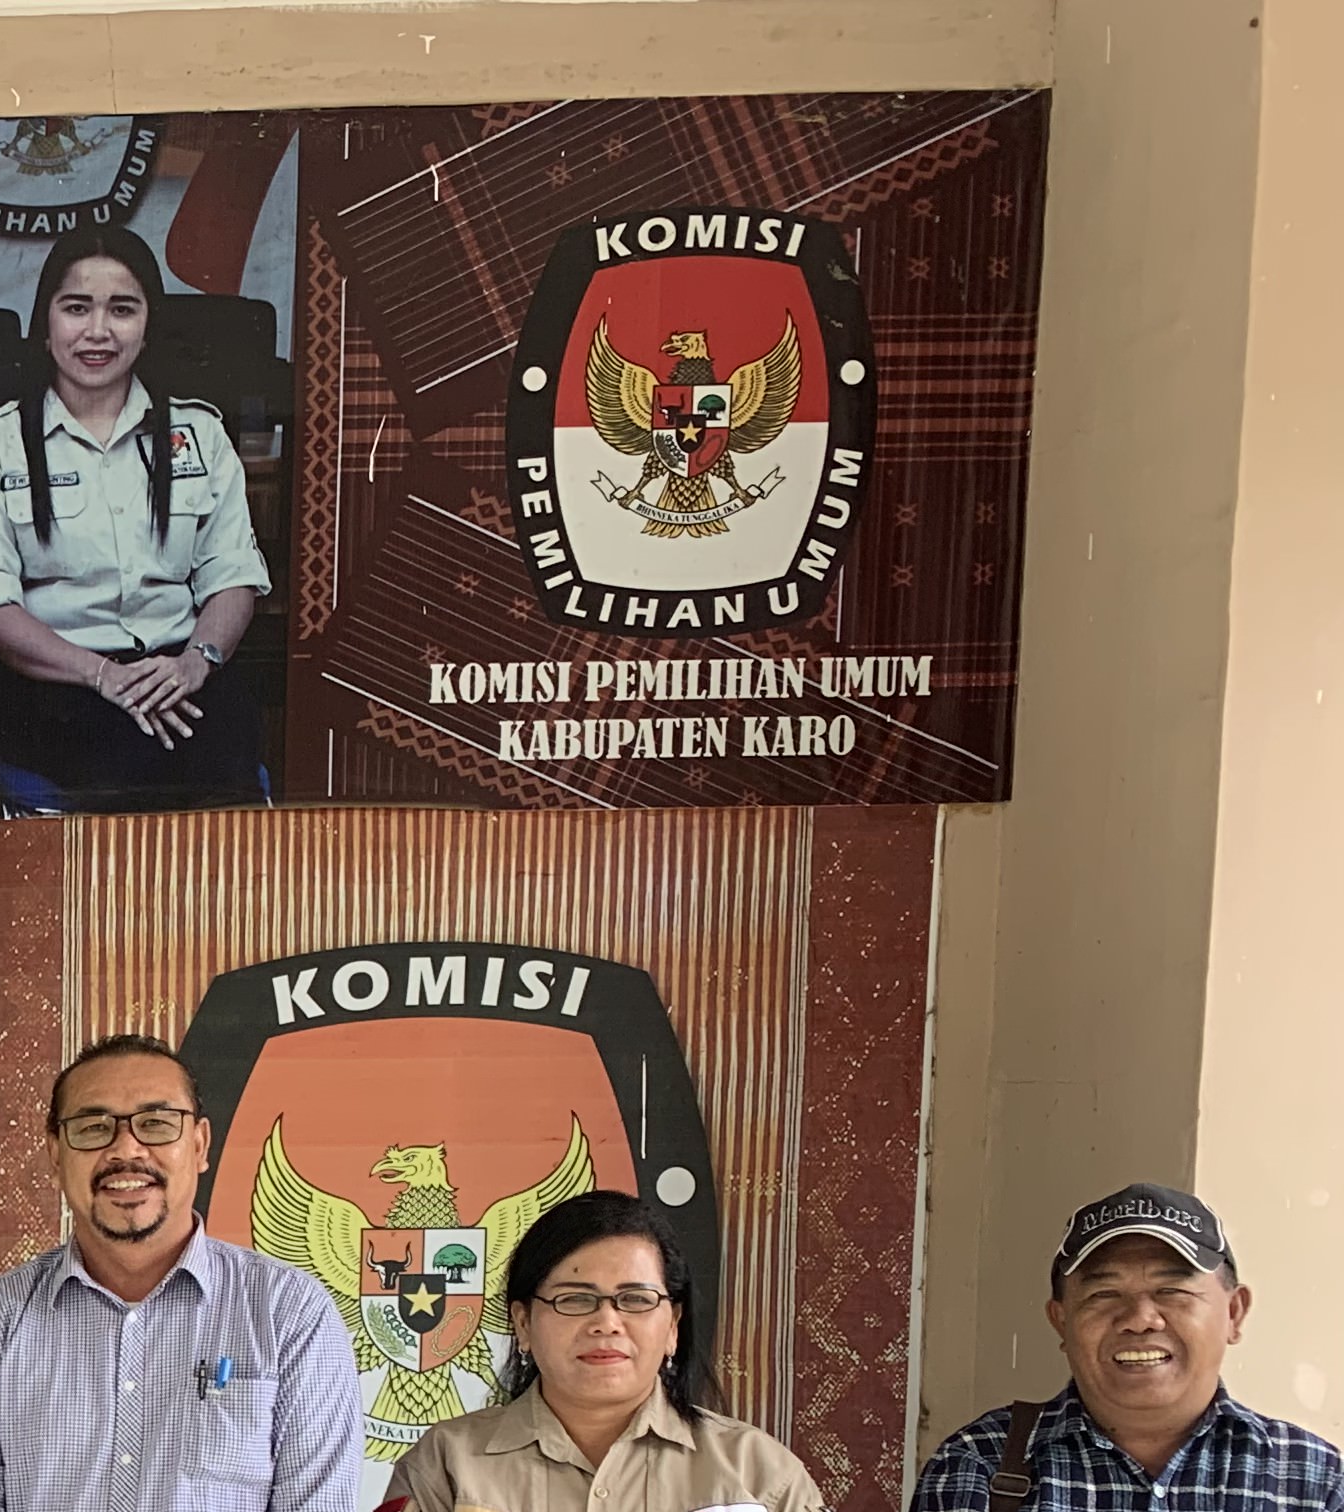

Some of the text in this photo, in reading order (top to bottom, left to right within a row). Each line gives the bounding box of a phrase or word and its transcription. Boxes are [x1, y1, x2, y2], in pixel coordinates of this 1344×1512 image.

[93, 129, 156, 224] UMUM
[595, 214, 805, 262] KOMISI
[636, 502, 740, 523] BHINNEKA TUNGGAL IKA
[517, 447, 864, 628] PEMILIHAN UMUM
[428, 655, 933, 704] KOMISI PEMILIHAN UMUM
[498, 714, 857, 761] KABUPATEN KARO
[272, 955, 591, 1026] KOMISI
